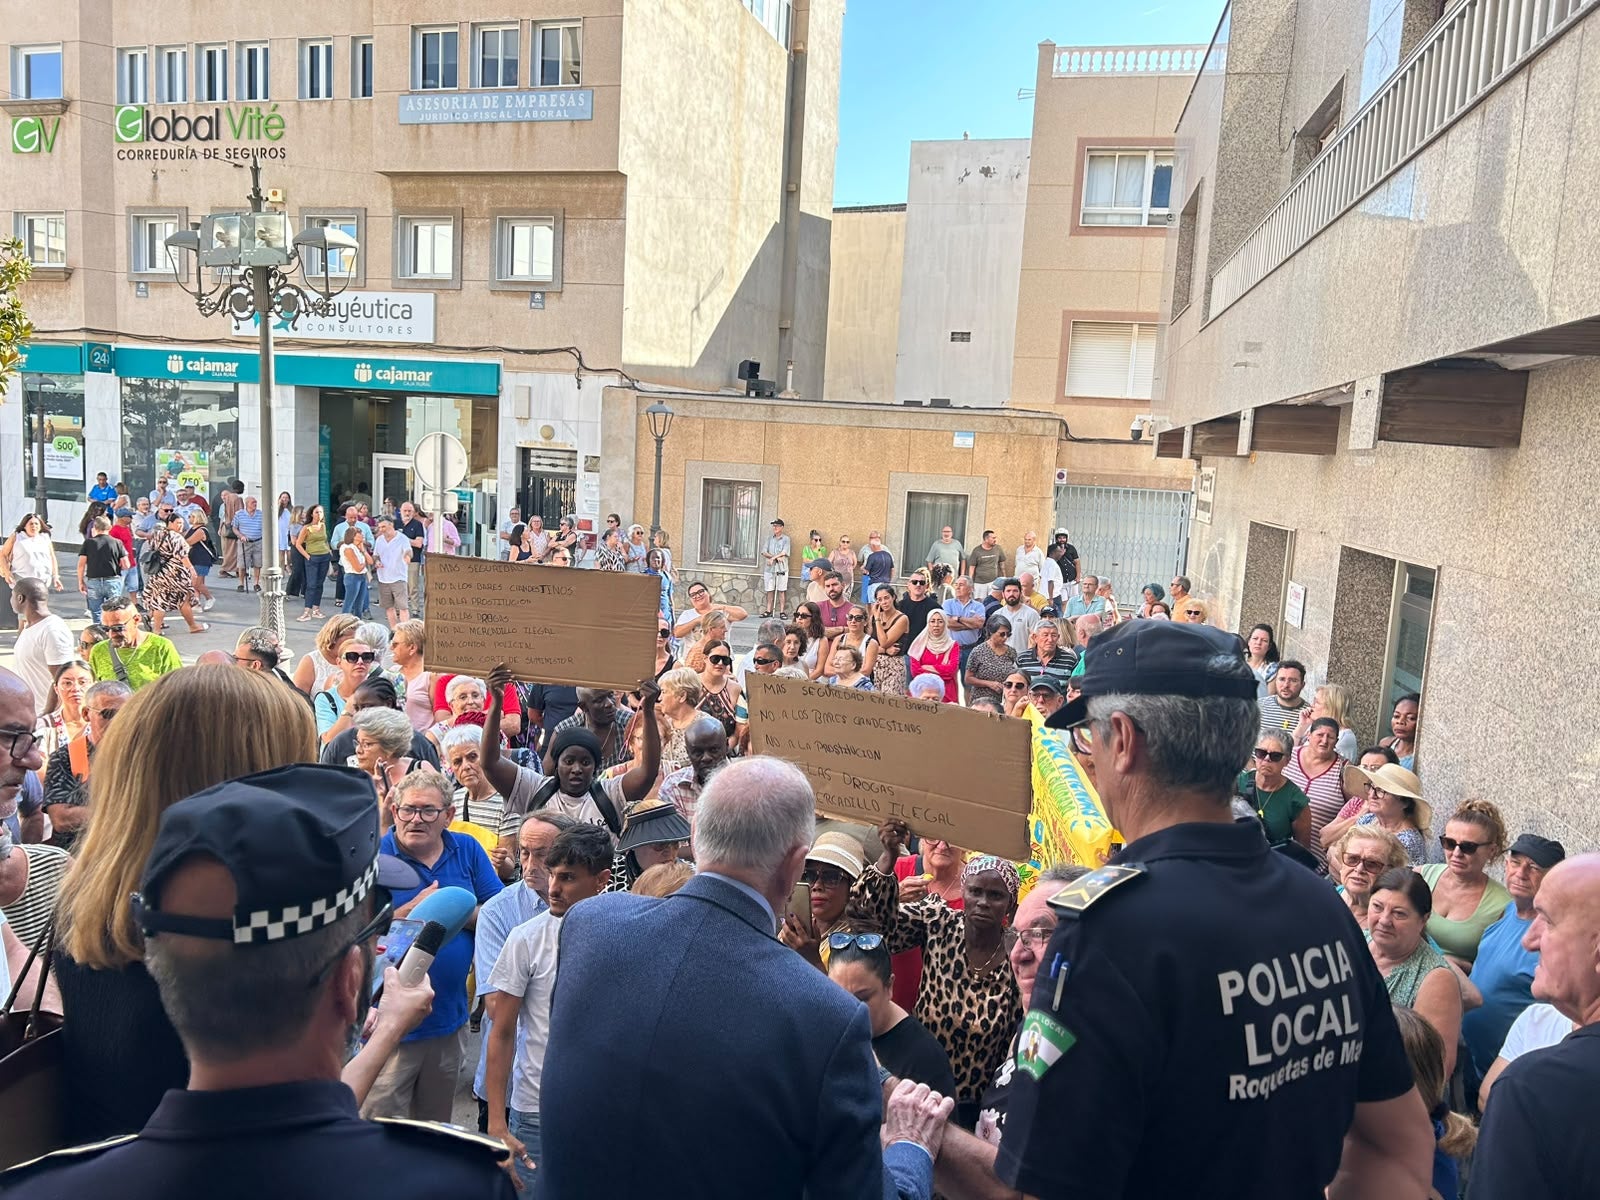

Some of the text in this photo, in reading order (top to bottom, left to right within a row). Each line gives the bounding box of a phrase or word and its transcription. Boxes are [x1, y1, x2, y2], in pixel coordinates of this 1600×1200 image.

[406, 93, 585, 111] ASESORIA DE EMPRESAS
[116, 103, 286, 142] Global Vité
[117, 146, 286, 161] CORREDURÍA DE SEGUROS
[307, 323, 413, 335] CONSULTORES
[186, 357, 239, 375] cajamar
[375, 366, 433, 384] cajamar
[435, 582, 447, 591] NO
[435, 597, 447, 606] NO
[436, 611, 448, 620] NO
[451, 612, 457, 620] A
[477, 613, 509, 623] DROGAS
[436, 625, 449, 634] NO
[453, 626, 464, 634] AL
[436, 655, 448, 663] NO
[763, 682, 787, 695] MAS
[870, 694, 885, 705] EN
[888, 698, 901, 709] EL
[759, 709, 775, 723] NO
[781, 710, 789, 720] A
[791, 708, 809, 721] LOS
[765, 733, 781, 748] NO
[787, 739, 796, 750] A
[797, 739, 812, 751] LA
[806, 761, 895, 797] LAS DROGAS
[815, 791, 956, 827] ERCADILLO ILEGAL
[1217, 940, 1354, 1016] POLICIA
[1244, 993, 1360, 1066] LOCAL
[1229, 1056, 1310, 1101] Roquetas
[1313, 1046, 1335, 1071] de
